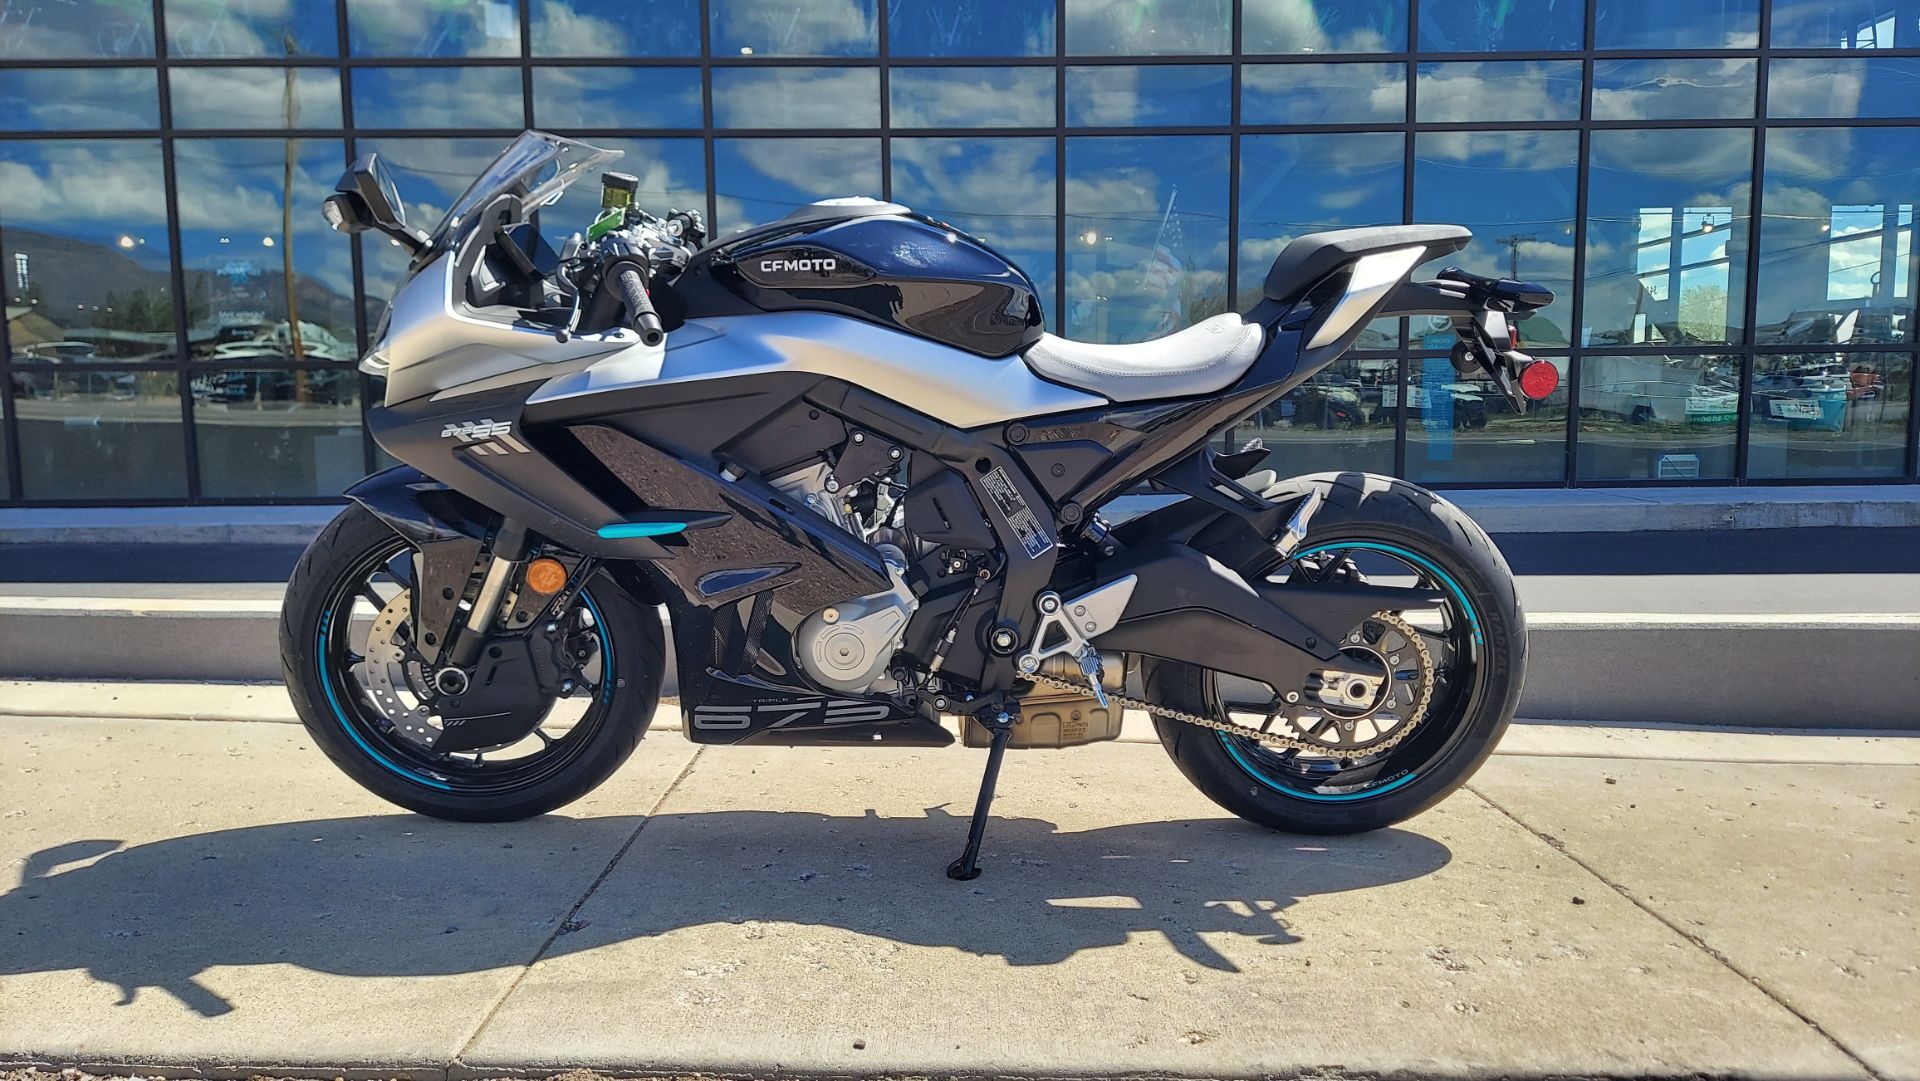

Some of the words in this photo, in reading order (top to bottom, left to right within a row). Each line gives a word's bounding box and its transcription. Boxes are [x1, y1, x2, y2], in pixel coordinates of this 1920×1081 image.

[760, 258, 836, 272] CFMOTO
[694, 700, 890, 730] 675
[1363, 769, 1409, 788] CFMOTO
